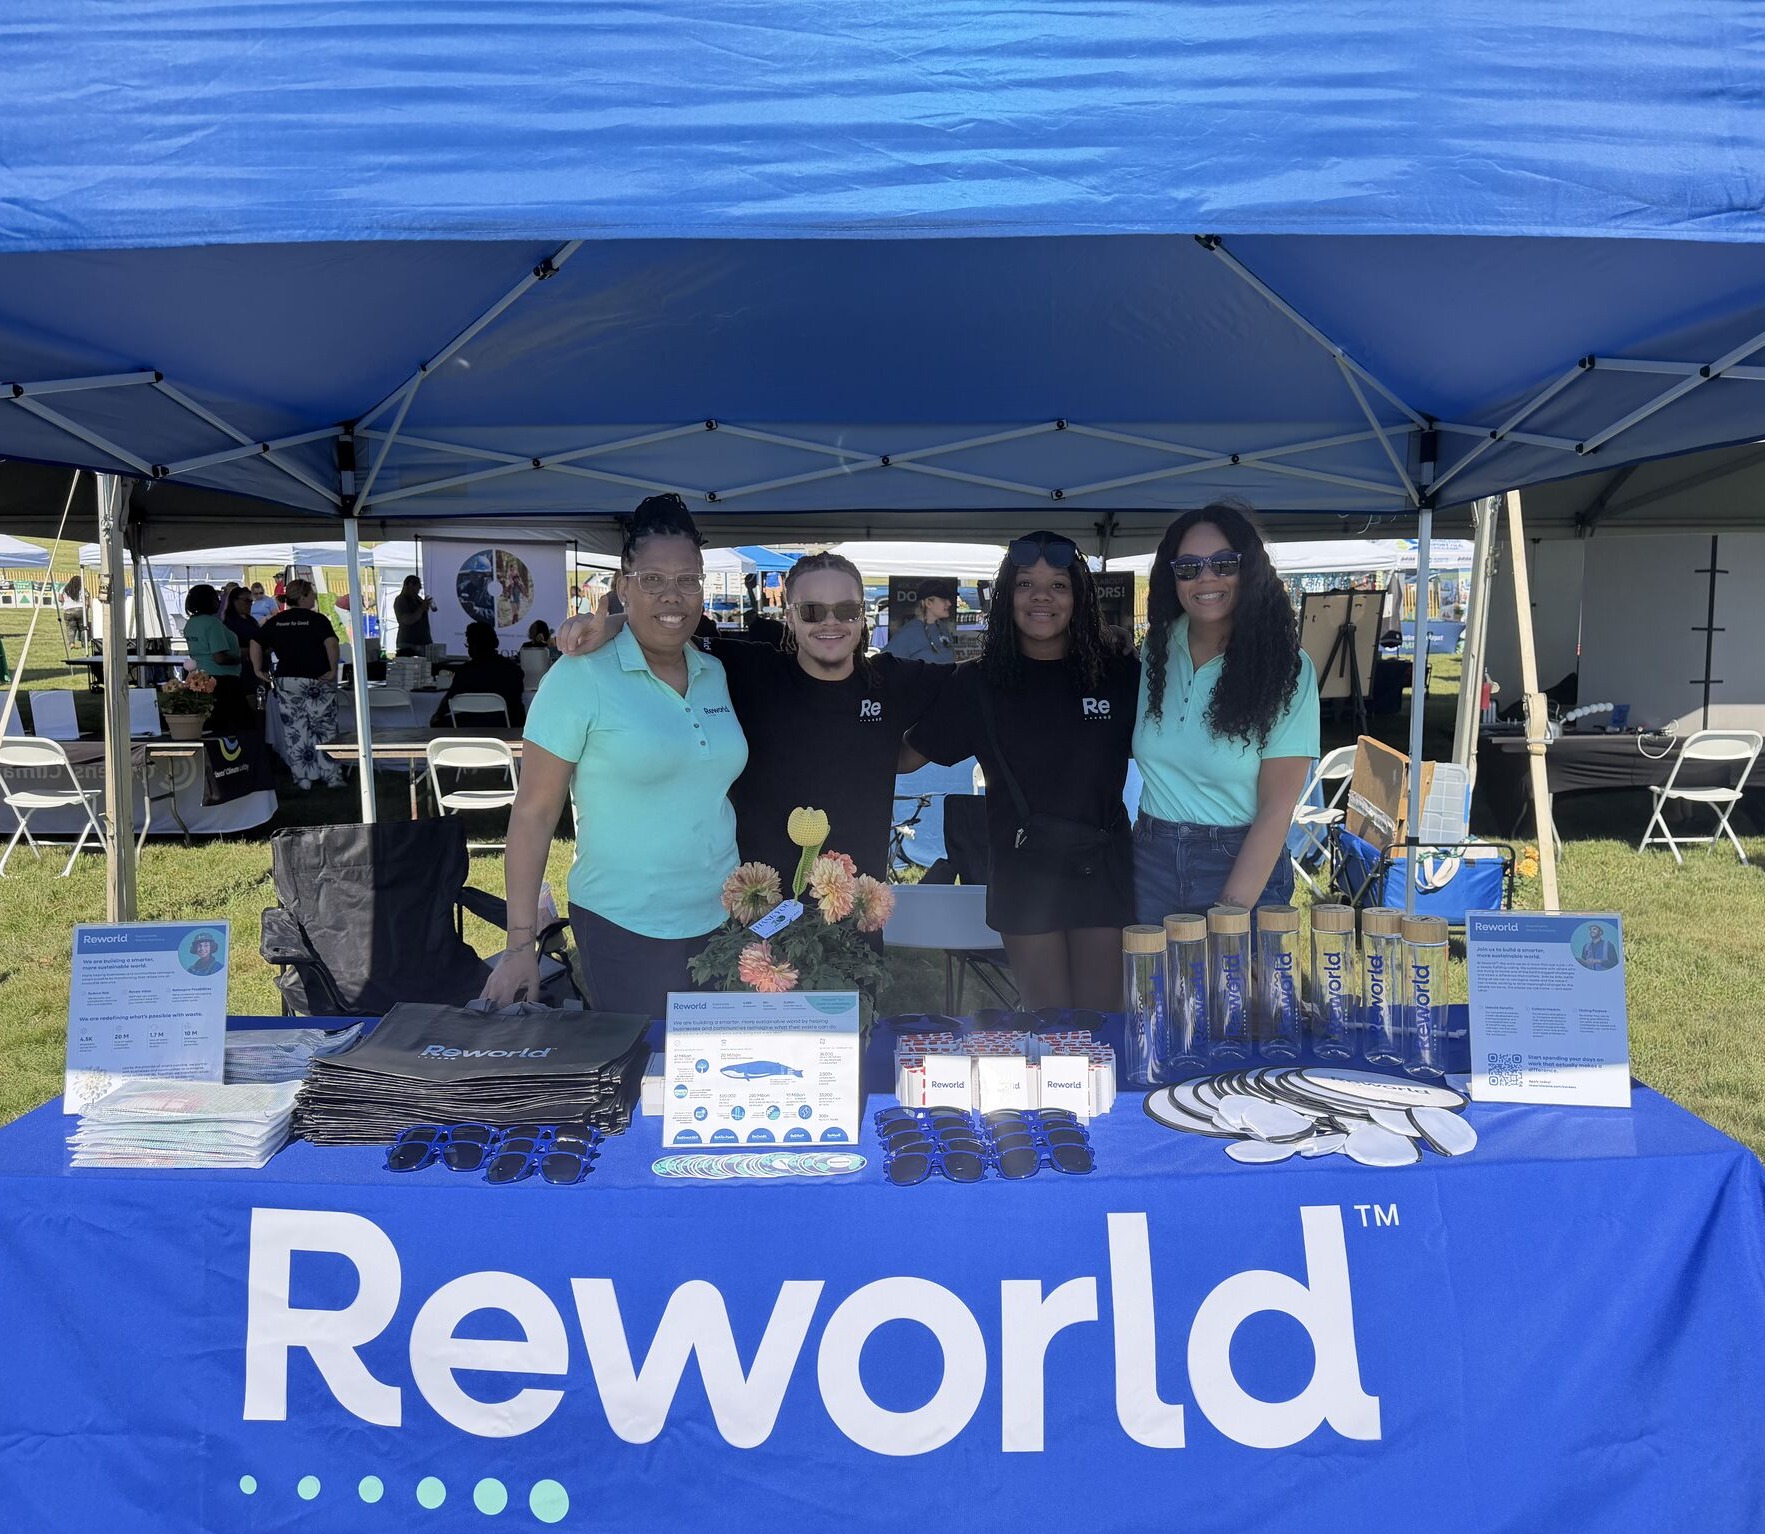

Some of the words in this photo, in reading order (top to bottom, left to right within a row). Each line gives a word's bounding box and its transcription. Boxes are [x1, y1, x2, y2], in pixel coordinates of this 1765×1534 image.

[704, 705, 730, 715] Reworld
[859, 699, 882, 717] Re
[1082, 698, 1110, 715] Re
[1475, 922, 1519, 932] Reworld
[83, 934, 128, 944] Reworld
[673, 1002, 707, 1010] Reworld
[420, 1044, 551, 1058] Reworld
[931, 1080, 965, 1089] Reworld
[1047, 1080, 1082, 1089] Reworld
[243, 1203, 1382, 1457] Reworld
